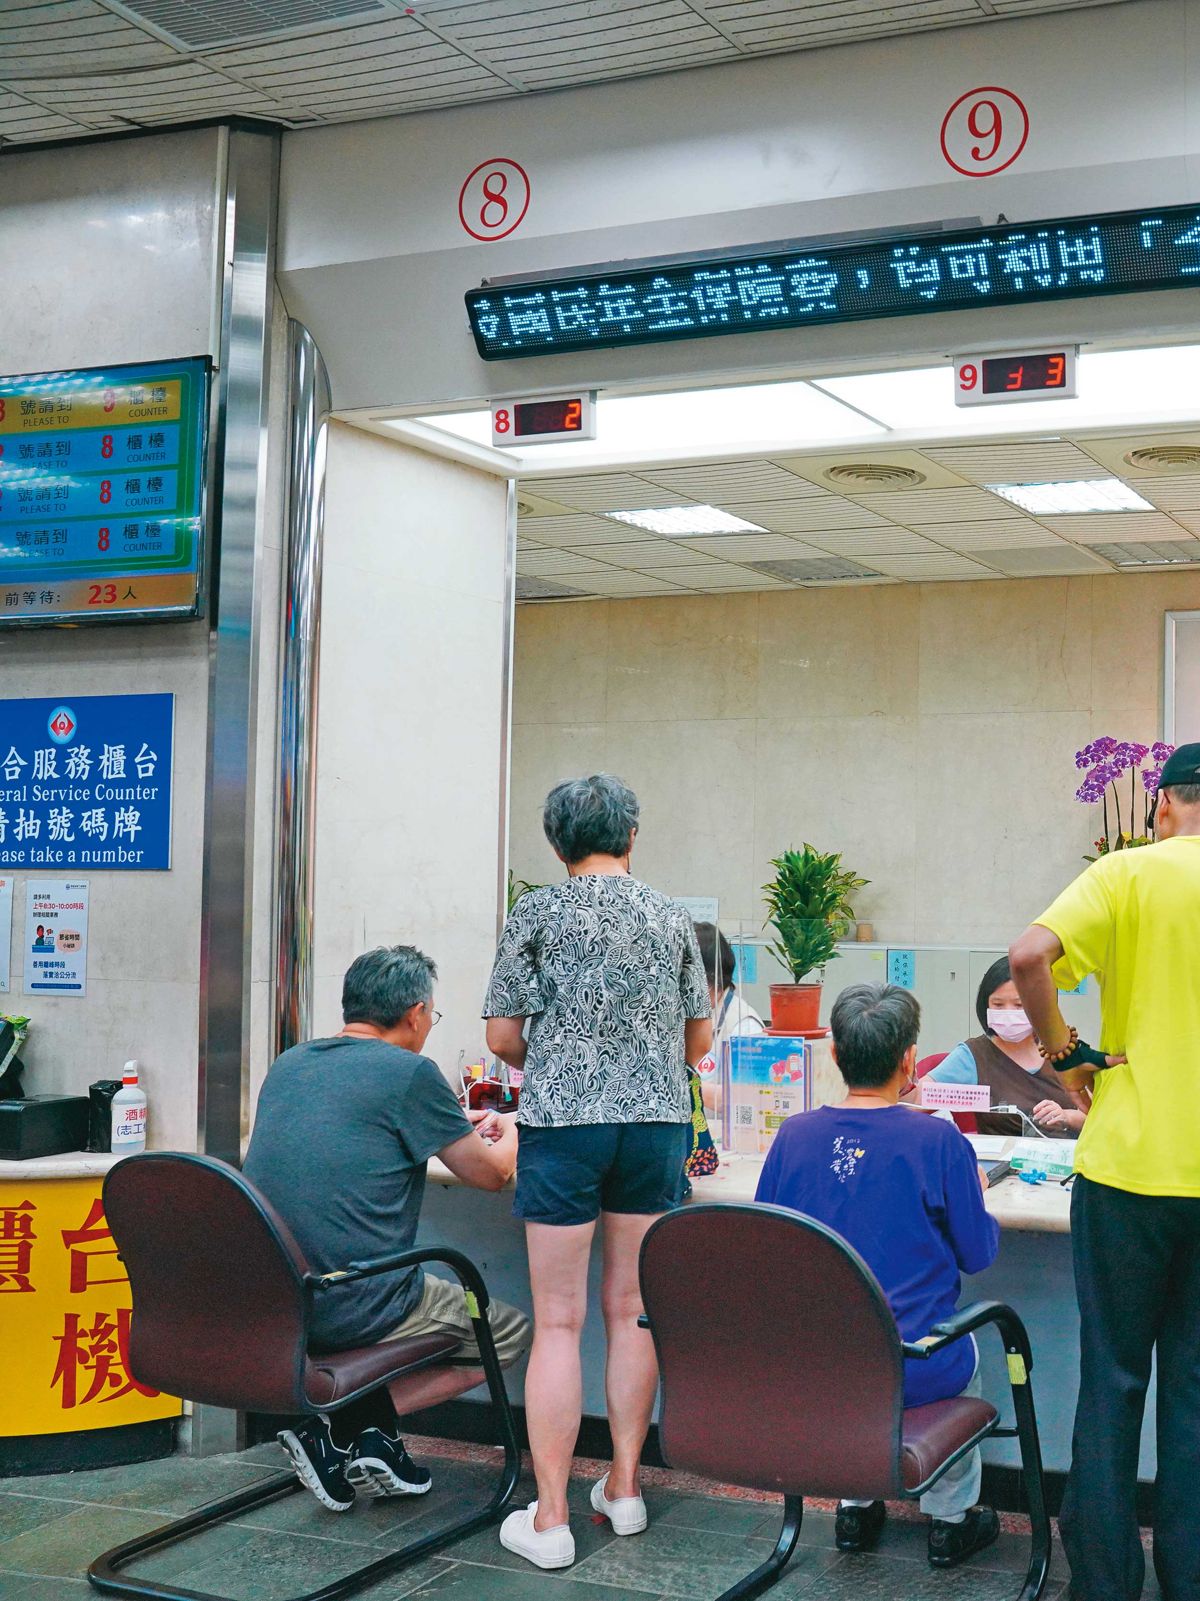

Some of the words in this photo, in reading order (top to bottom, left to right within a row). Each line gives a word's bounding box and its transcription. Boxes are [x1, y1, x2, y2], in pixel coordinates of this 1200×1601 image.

[959, 364, 978, 391] 9
[23, 417, 54, 428] PLEASE
[57, 415, 70, 424] TO
[128, 406, 168, 418] COUNTER
[495, 409, 510, 434] 8
[18, 440, 71, 460] 號請到
[101, 434, 114, 459] 8
[55, 459, 68, 469] TO
[127, 451, 166, 463] COUNTER
[99, 479, 112, 504] 8
[20, 503, 51, 514] PLEASE
[54, 502, 67, 512] TO
[125, 495, 164, 508] COUNTER
[15, 527, 68, 547] 號請到
[97, 527, 110, 551] 8
[123, 541, 162, 553] COUNTER
[88, 583, 118, 605] 23
[122, 586, 137, 601] 人
[1, 743, 158, 782] 合服務櫃台
[32, 785, 90, 802] Service
[95, 783, 159, 801] Counter
[30, 846, 64, 863] take
[68, 850, 76, 863] a
[81, 845, 144, 864] number
